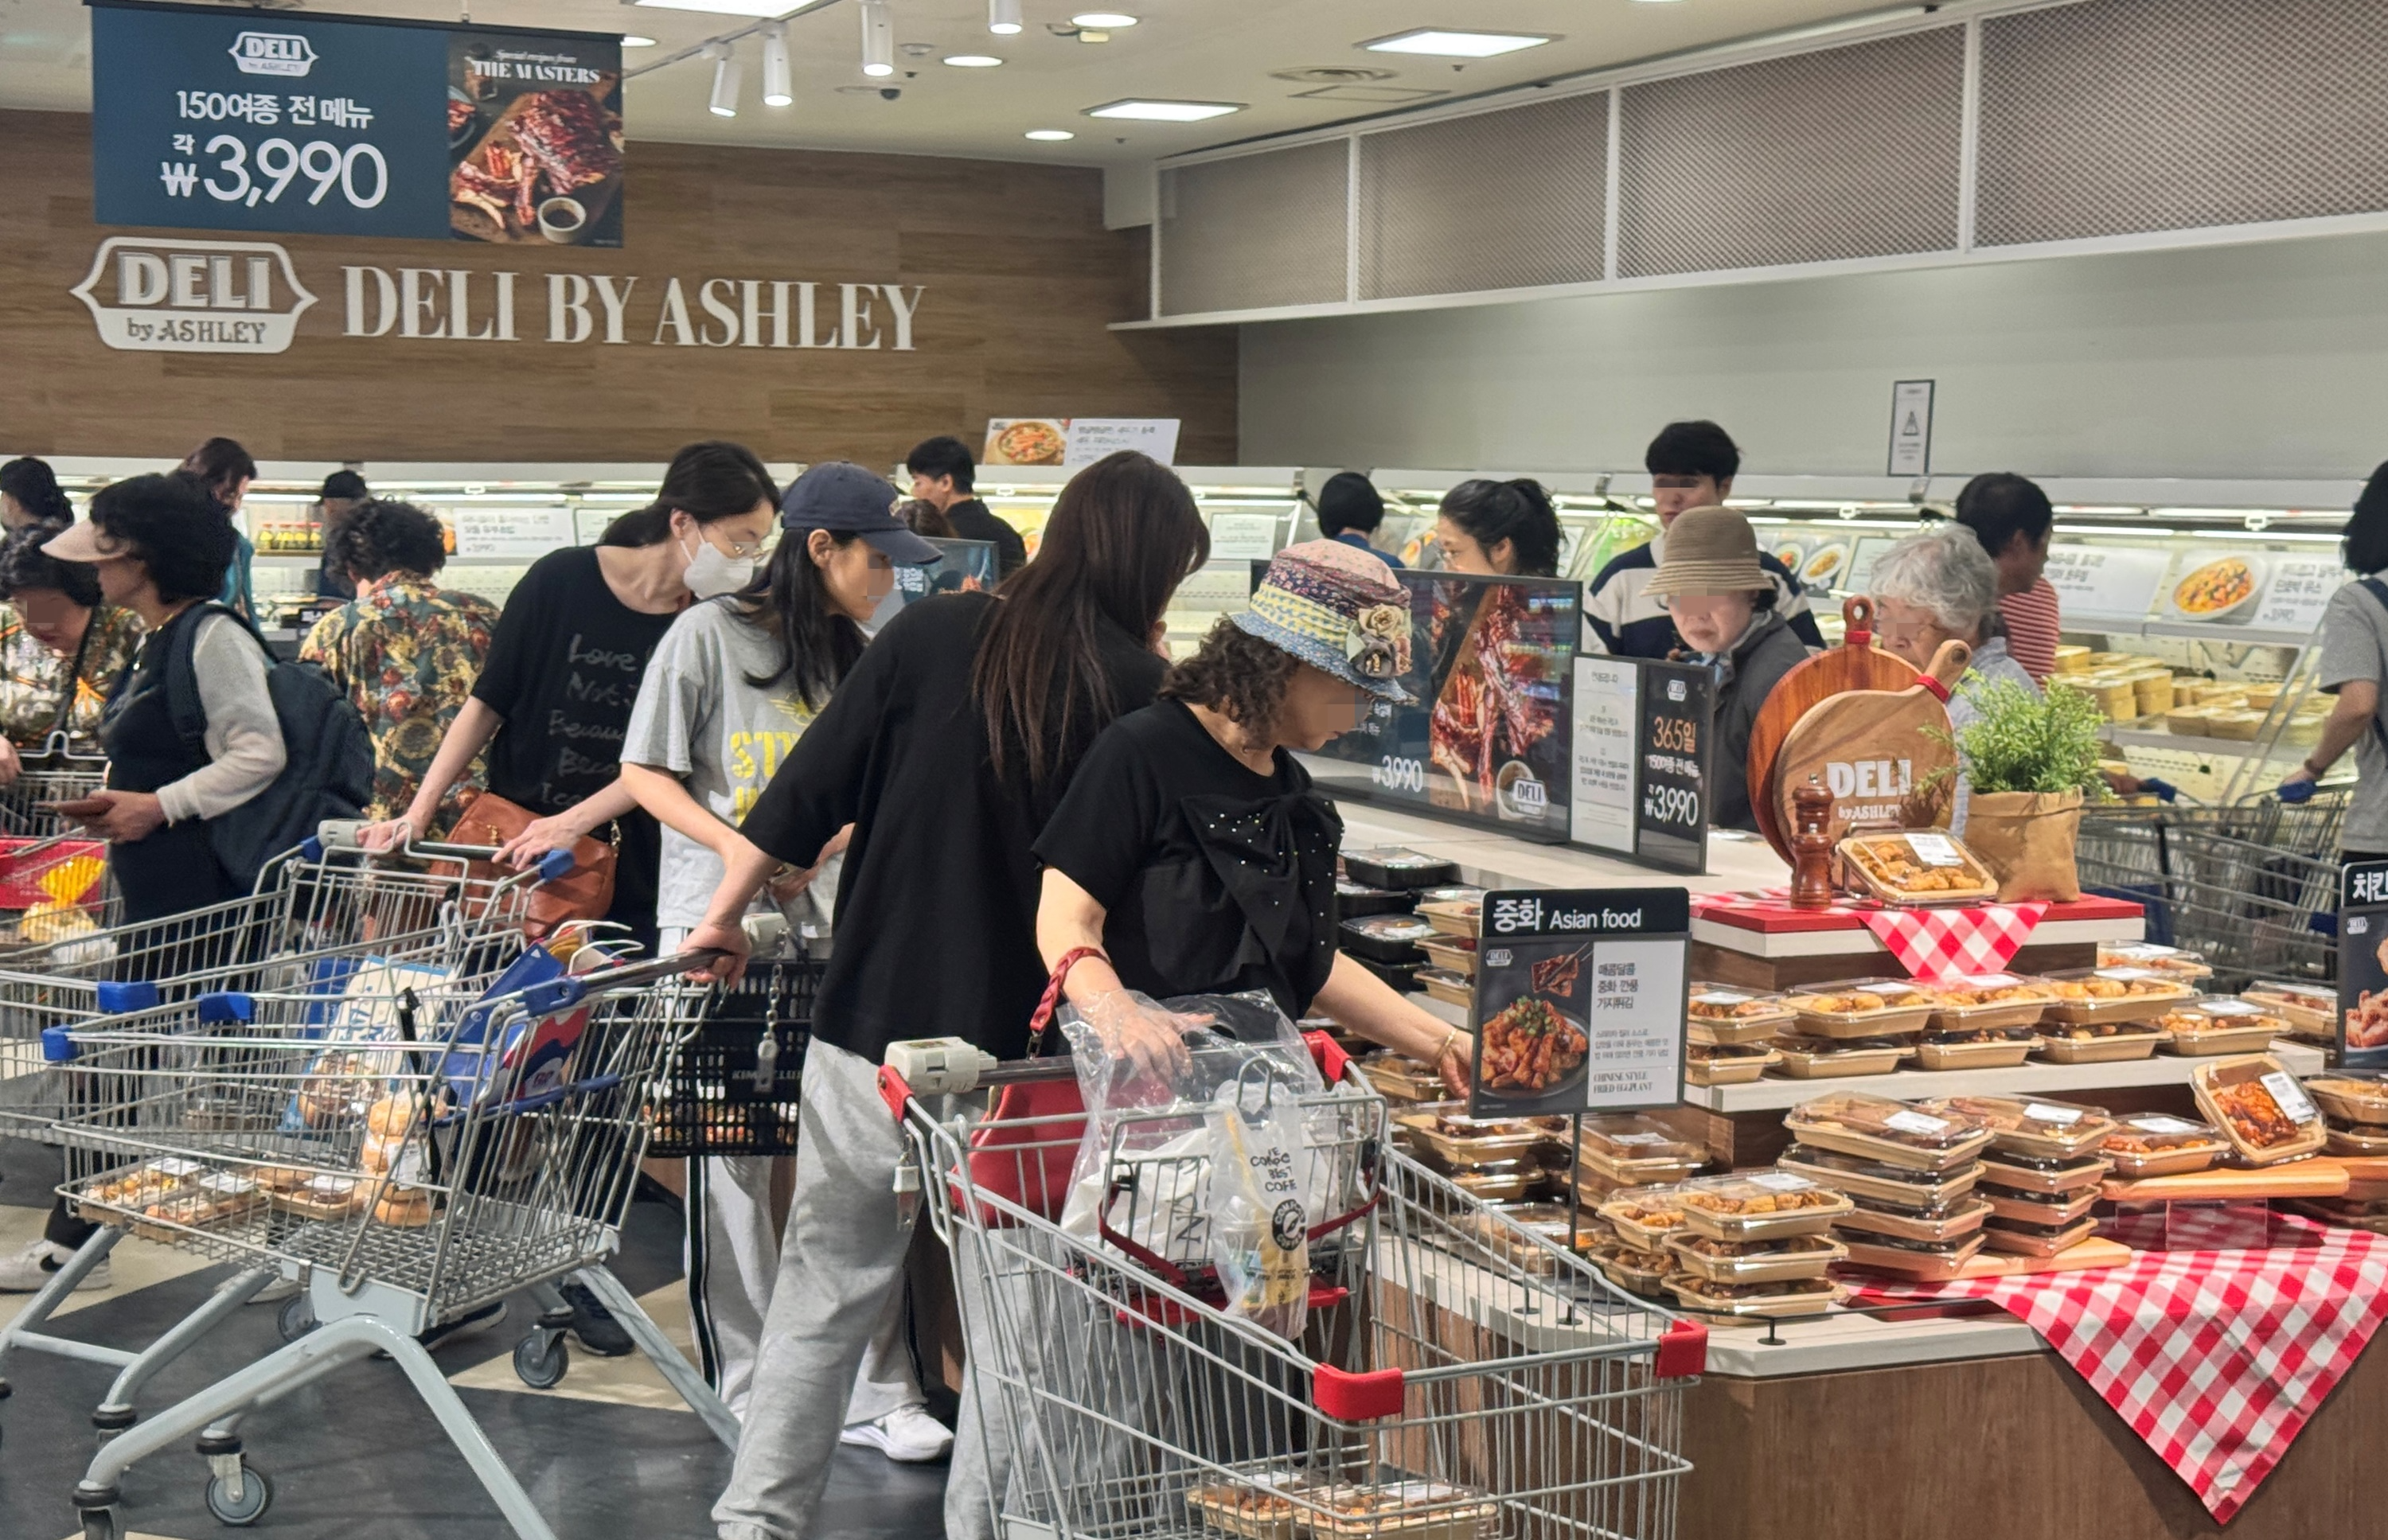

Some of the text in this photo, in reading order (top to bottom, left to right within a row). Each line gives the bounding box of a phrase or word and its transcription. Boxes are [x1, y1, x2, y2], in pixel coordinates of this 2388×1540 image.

[246, 37, 302, 60] DELI
[473, 60, 600, 84] THE MASTERS
[177, 90, 282, 125] 150여종
[172, 134, 195, 155] 각
[117, 251, 271, 310] DELI
[341, 265, 927, 351] DELI BY ASHLEY
[127, 318, 267, 344] by ASHLEY
[568, 634, 638, 672] Love
[1653, 715, 1696, 754] 365일
[1518, 782, 1542, 801] DELI
[1826, 759, 1911, 798] DELI
[1492, 898, 1641, 933] 중화 Asian food
[1597, 980, 1617, 993] 중화
[1597, 996, 1634, 1011] 가지튀김
